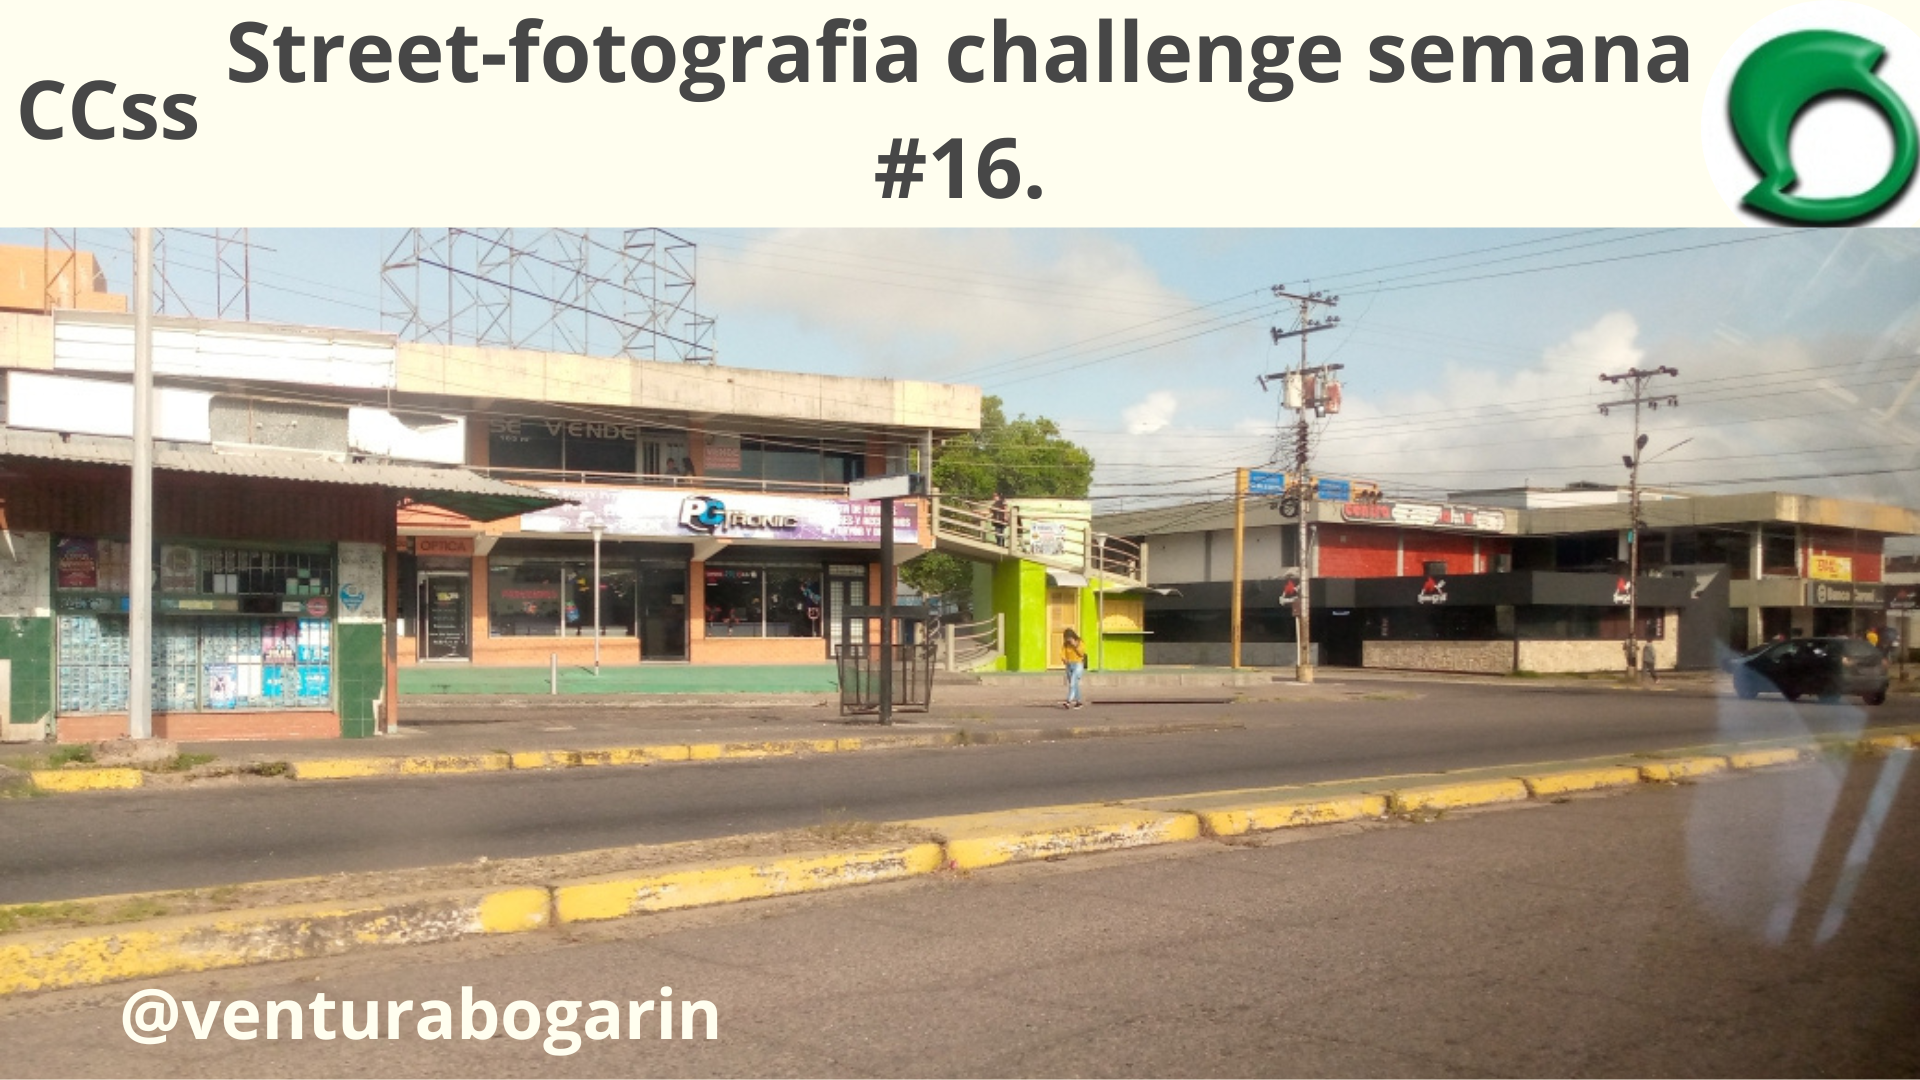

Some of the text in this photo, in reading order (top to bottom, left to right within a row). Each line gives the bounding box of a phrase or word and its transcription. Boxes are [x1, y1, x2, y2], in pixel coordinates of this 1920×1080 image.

[490, 418, 635, 441] SE VENDE
[420, 540, 466, 552] OPTICA
